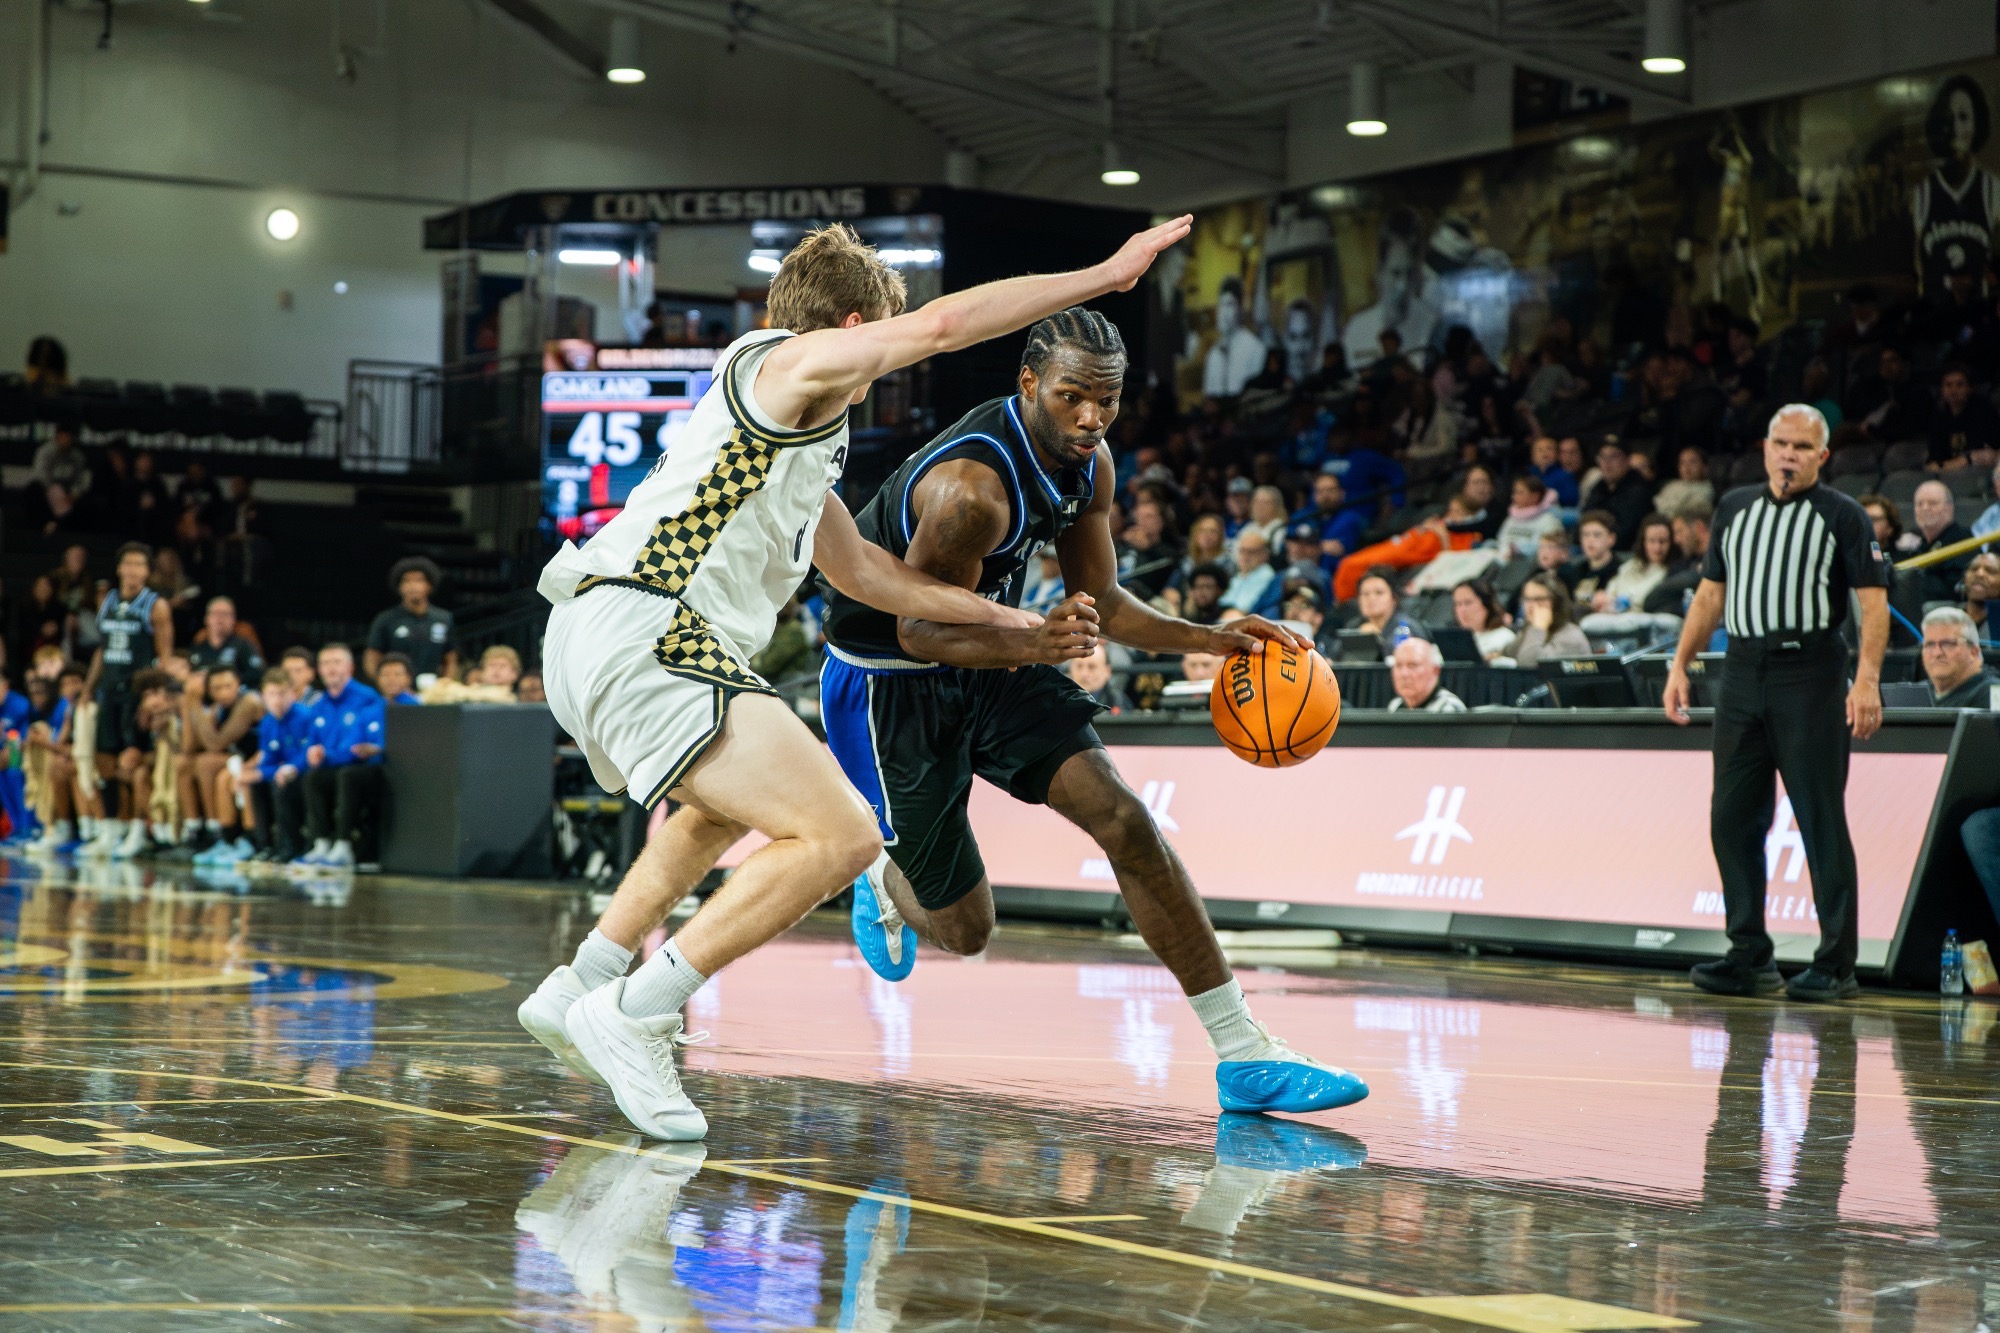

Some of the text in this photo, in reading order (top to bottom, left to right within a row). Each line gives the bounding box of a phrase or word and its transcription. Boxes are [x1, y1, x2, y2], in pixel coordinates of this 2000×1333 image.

[593, 187, 866, 221] CONCESSIONS
[546, 376, 652, 398] OAKLAND
[567, 410, 643, 467] 45
[1230, 647, 1256, 709] Wils
